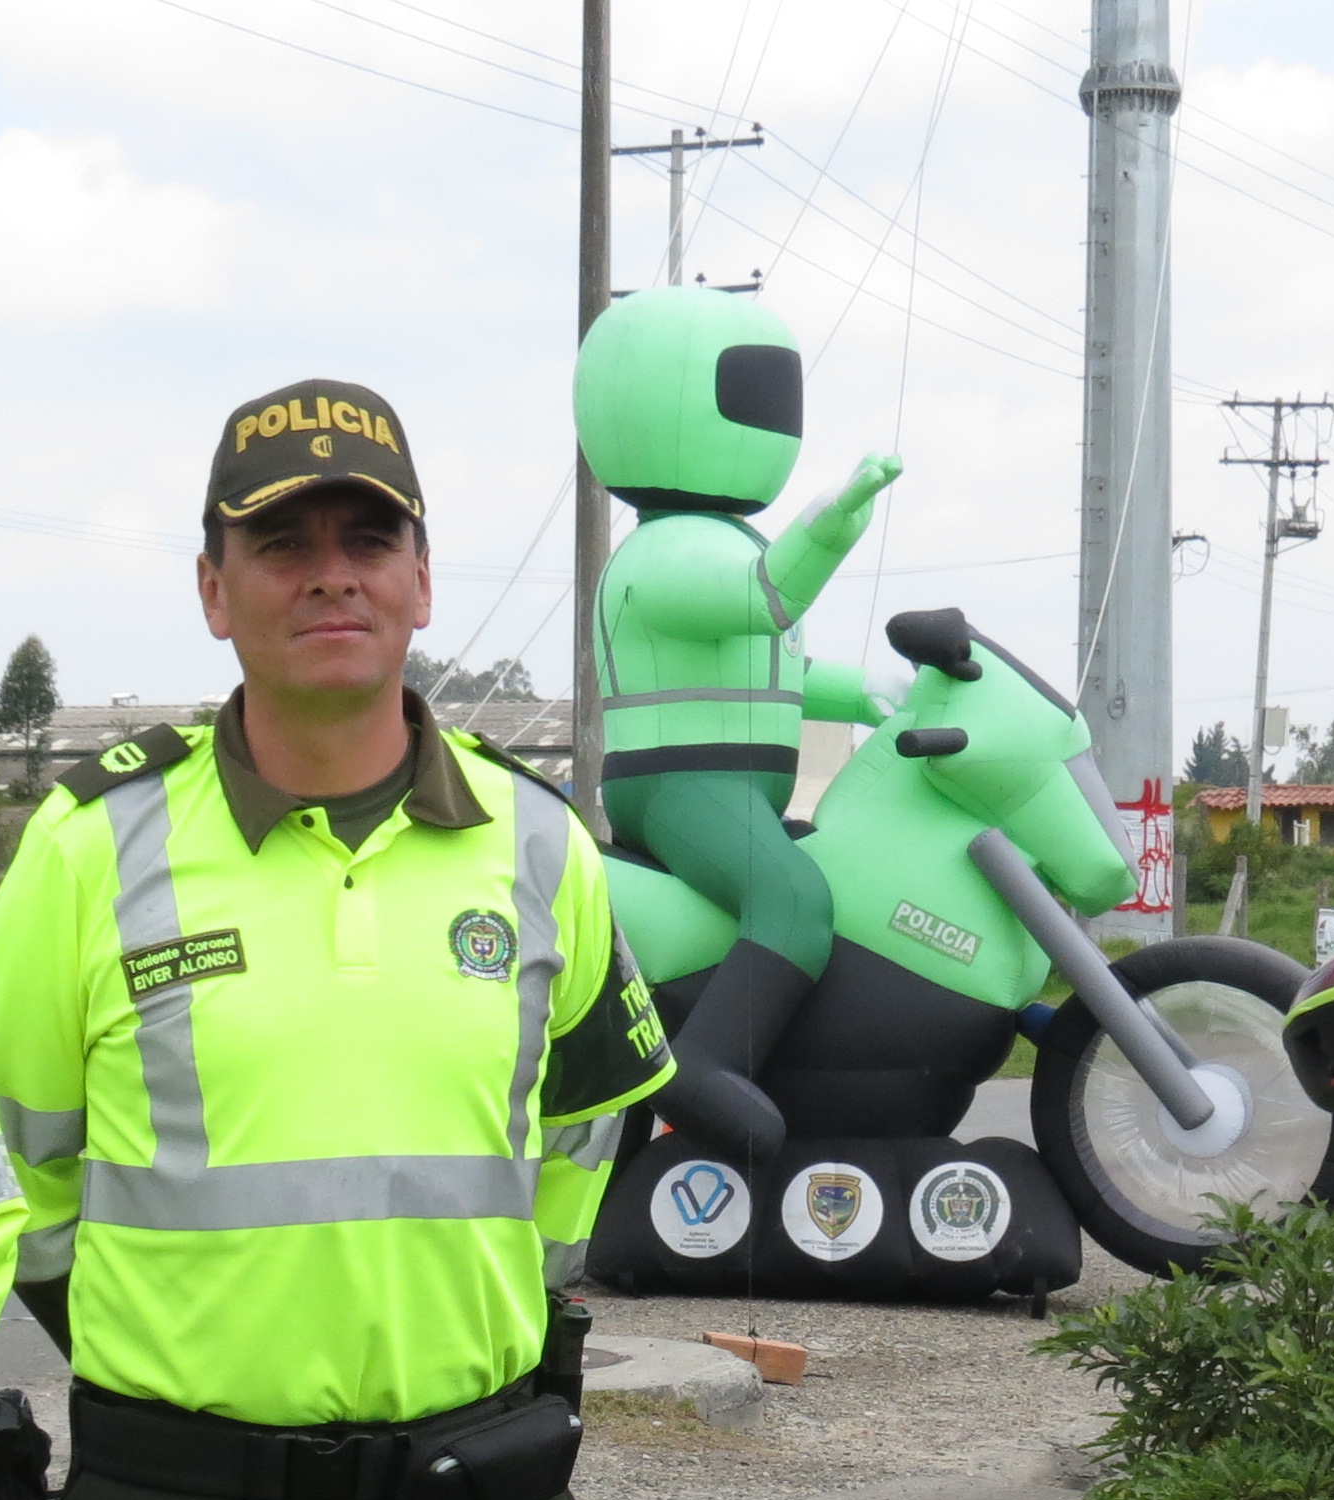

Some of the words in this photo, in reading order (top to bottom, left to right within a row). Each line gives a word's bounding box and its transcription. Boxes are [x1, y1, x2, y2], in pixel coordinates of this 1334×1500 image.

[235, 396, 400, 454] POLICIA
[127, 948, 180, 973] Teniente
[184, 934, 236, 955] Coronel
[893, 901, 977, 957] POLICIA
[133, 965, 173, 991] EIVER
[178, 949, 238, 976] ALONSO
